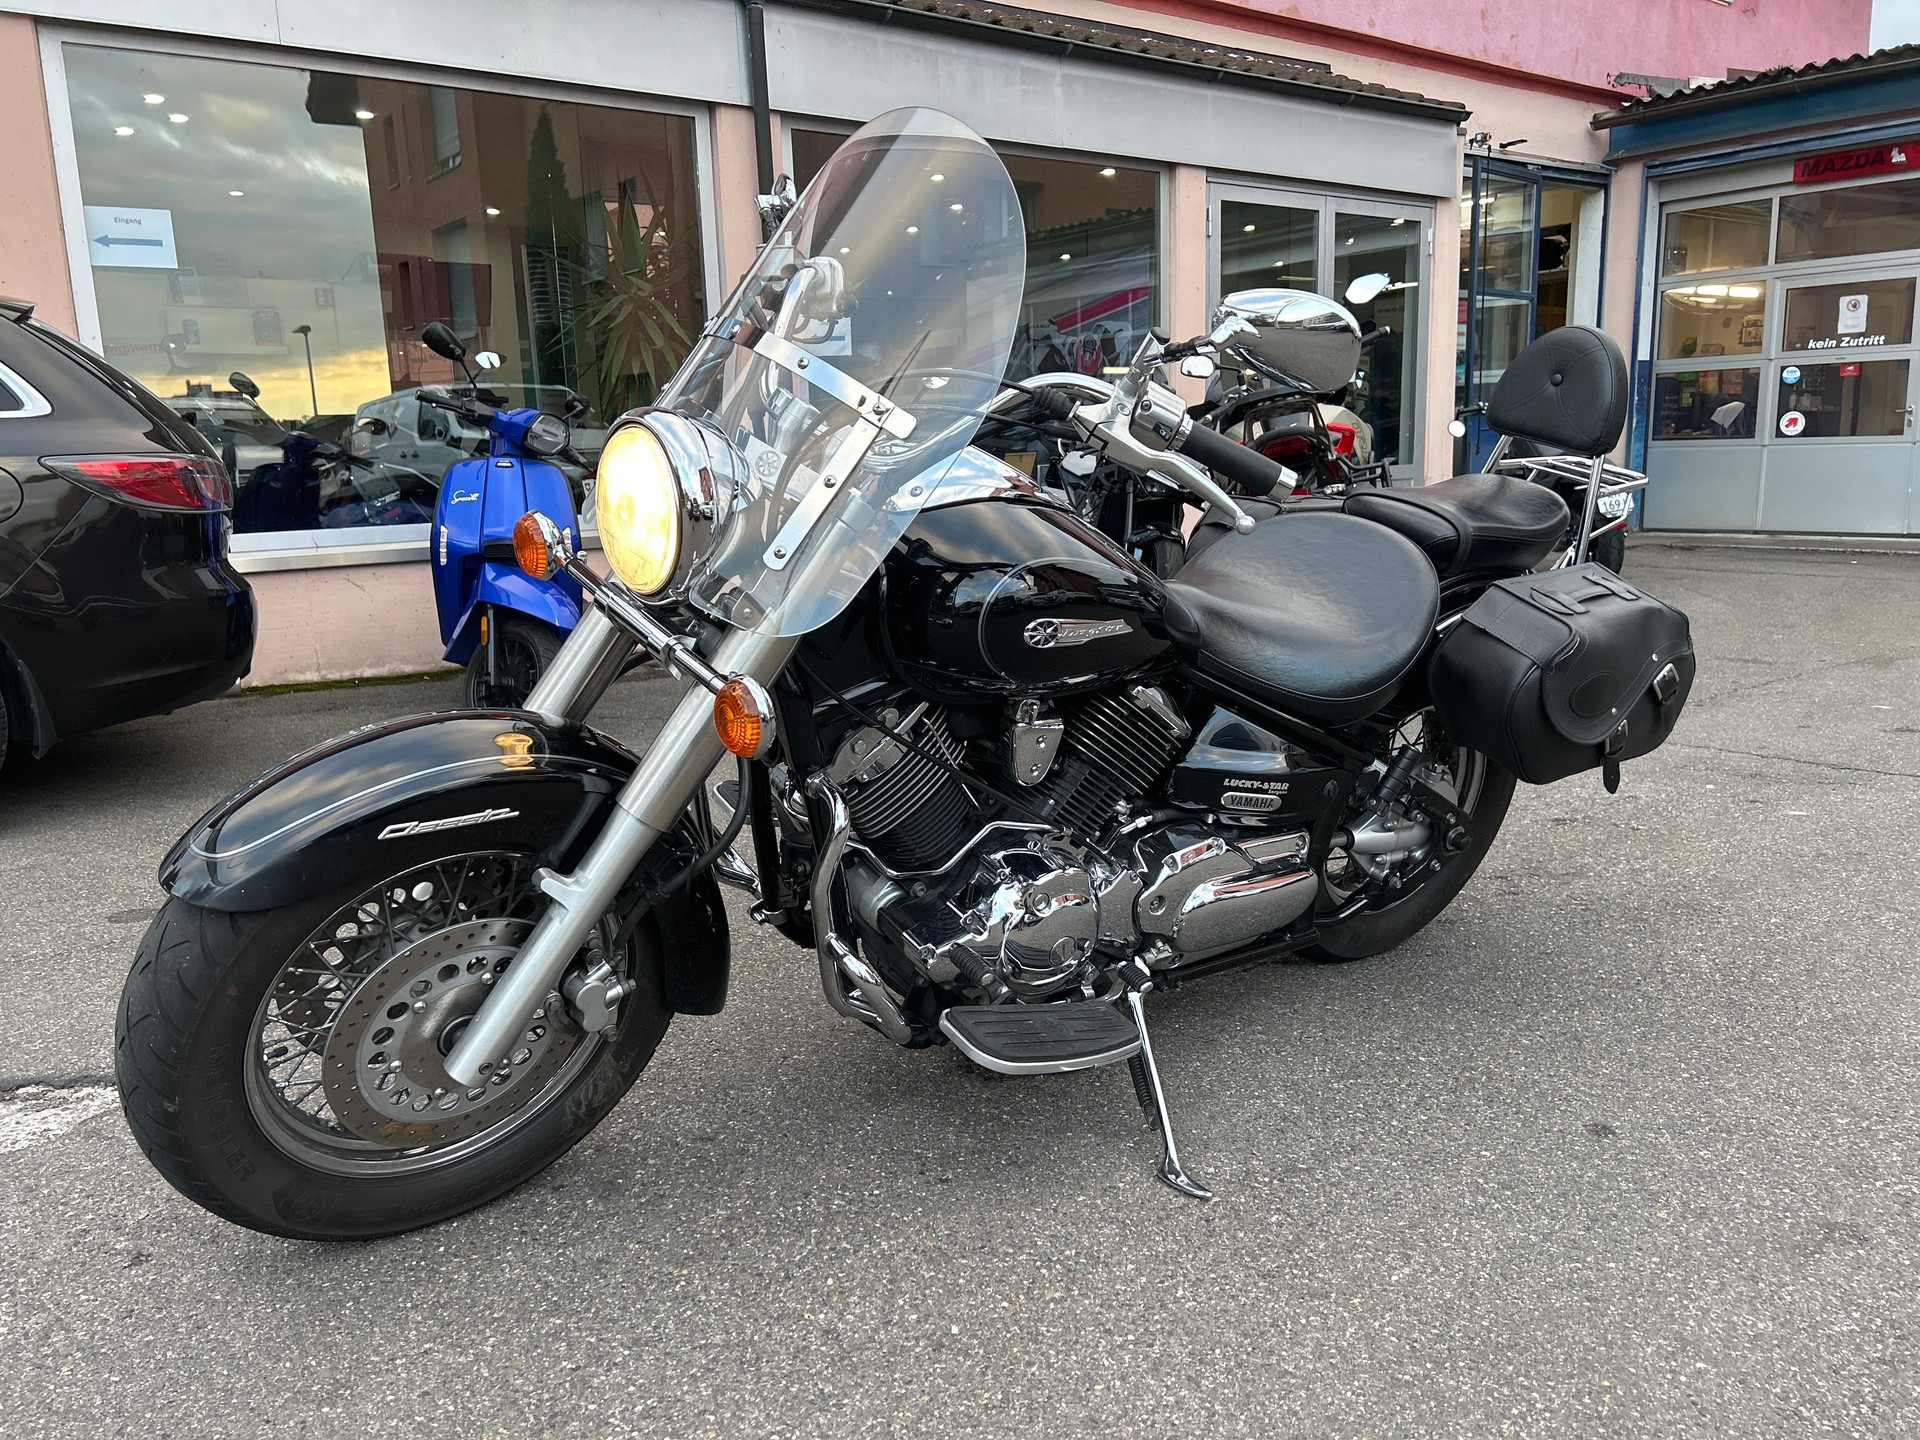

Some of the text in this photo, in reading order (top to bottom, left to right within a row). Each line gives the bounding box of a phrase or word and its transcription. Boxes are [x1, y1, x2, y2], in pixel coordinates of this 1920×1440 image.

[1801, 150, 1886, 178] MAZDA
[113, 216, 142, 226] Eingang
[1807, 334, 1886, 349] kein Zutritt
[1223, 778, 1290, 790] LUCKY-STAR
[1231, 795, 1274, 809] YAMAHA
[377, 807, 520, 840] Classic
